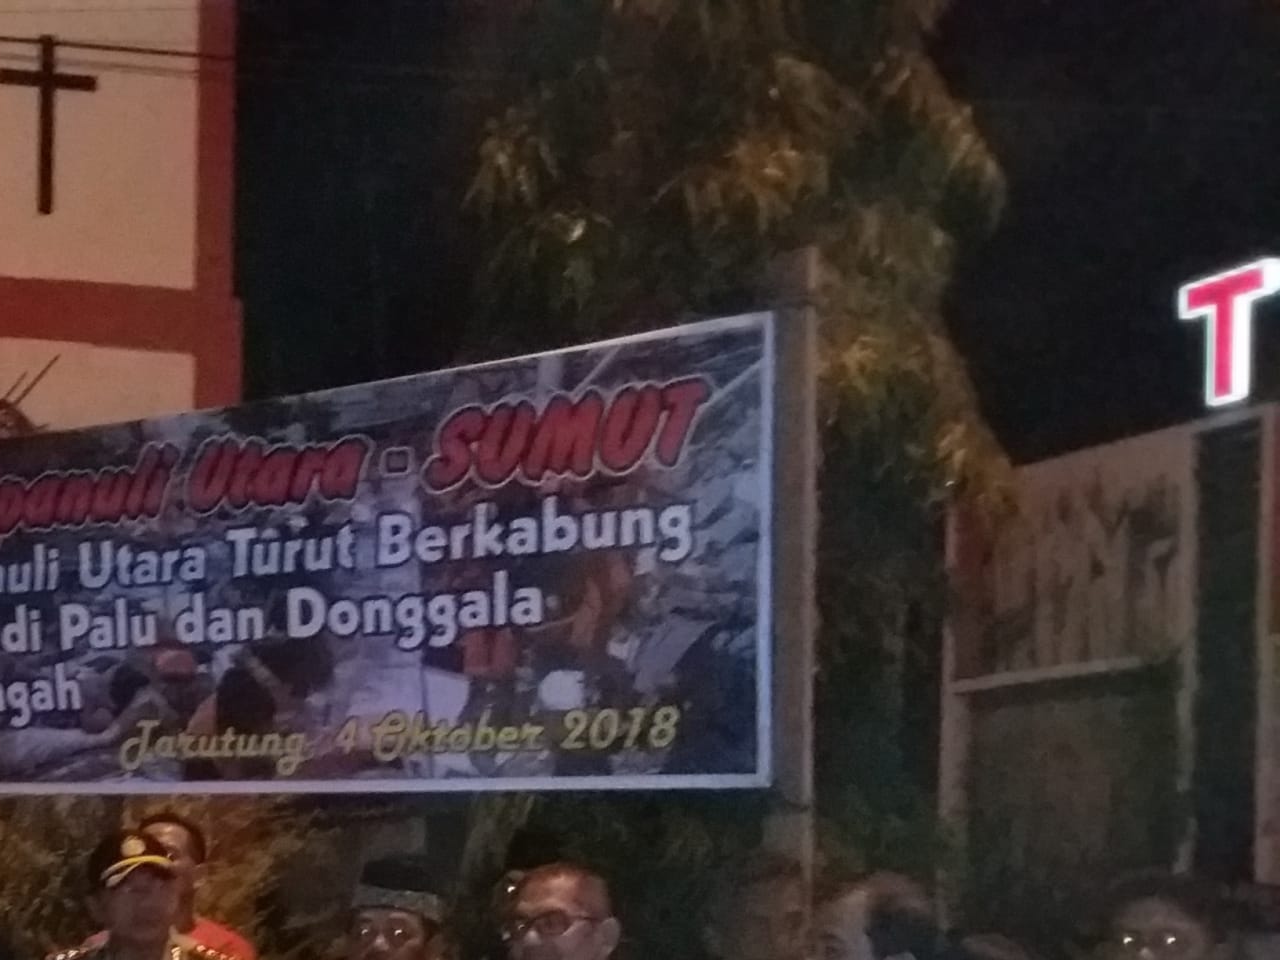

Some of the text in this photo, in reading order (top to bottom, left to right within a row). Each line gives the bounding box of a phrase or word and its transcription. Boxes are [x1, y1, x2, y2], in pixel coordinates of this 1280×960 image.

[184, 432, 374, 518] Utara
[422, 374, 713, 494] SUMUT
[78, 540, 206, 589] Utara
[226, 520, 356, 578] Turut
[377, 495, 692, 567] Berkabung
[0, 603, 42, 653] di
[59, 598, 157, 650] Palu
[175, 592, 264, 643] dan
[286, 569, 544, 650] Donggala
[335, 714, 359, 755] 4
[370, 703, 544, 763] Oktober
[558, 703, 681, 752] 2018
